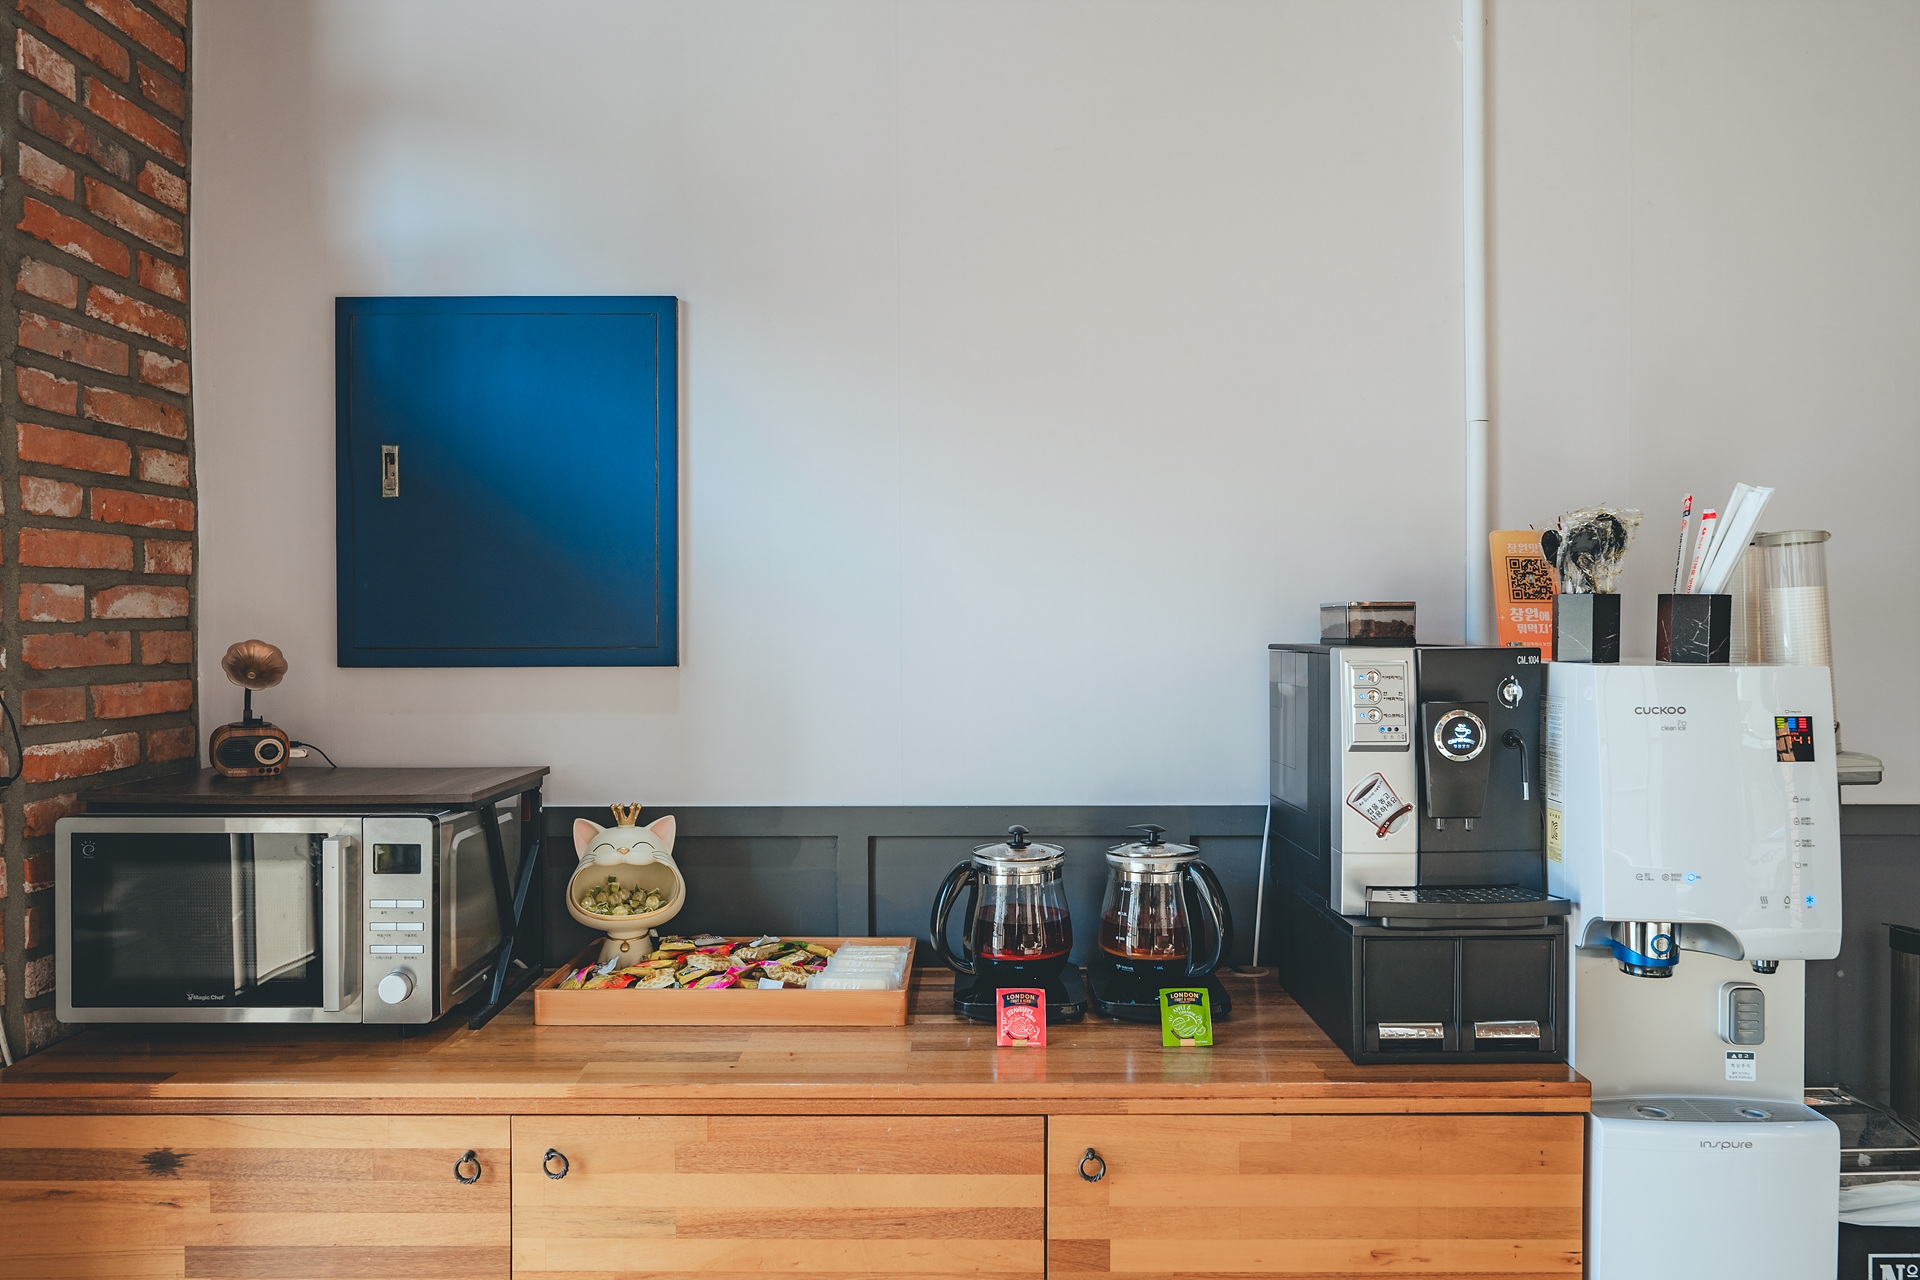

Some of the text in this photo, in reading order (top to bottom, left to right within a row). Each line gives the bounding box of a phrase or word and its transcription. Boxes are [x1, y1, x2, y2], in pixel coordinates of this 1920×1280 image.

[1510, 607, 1552, 622] 창원에
[1634, 706, 1687, 715] CUCKOO
[1006, 993, 1036, 1001] LONDON
